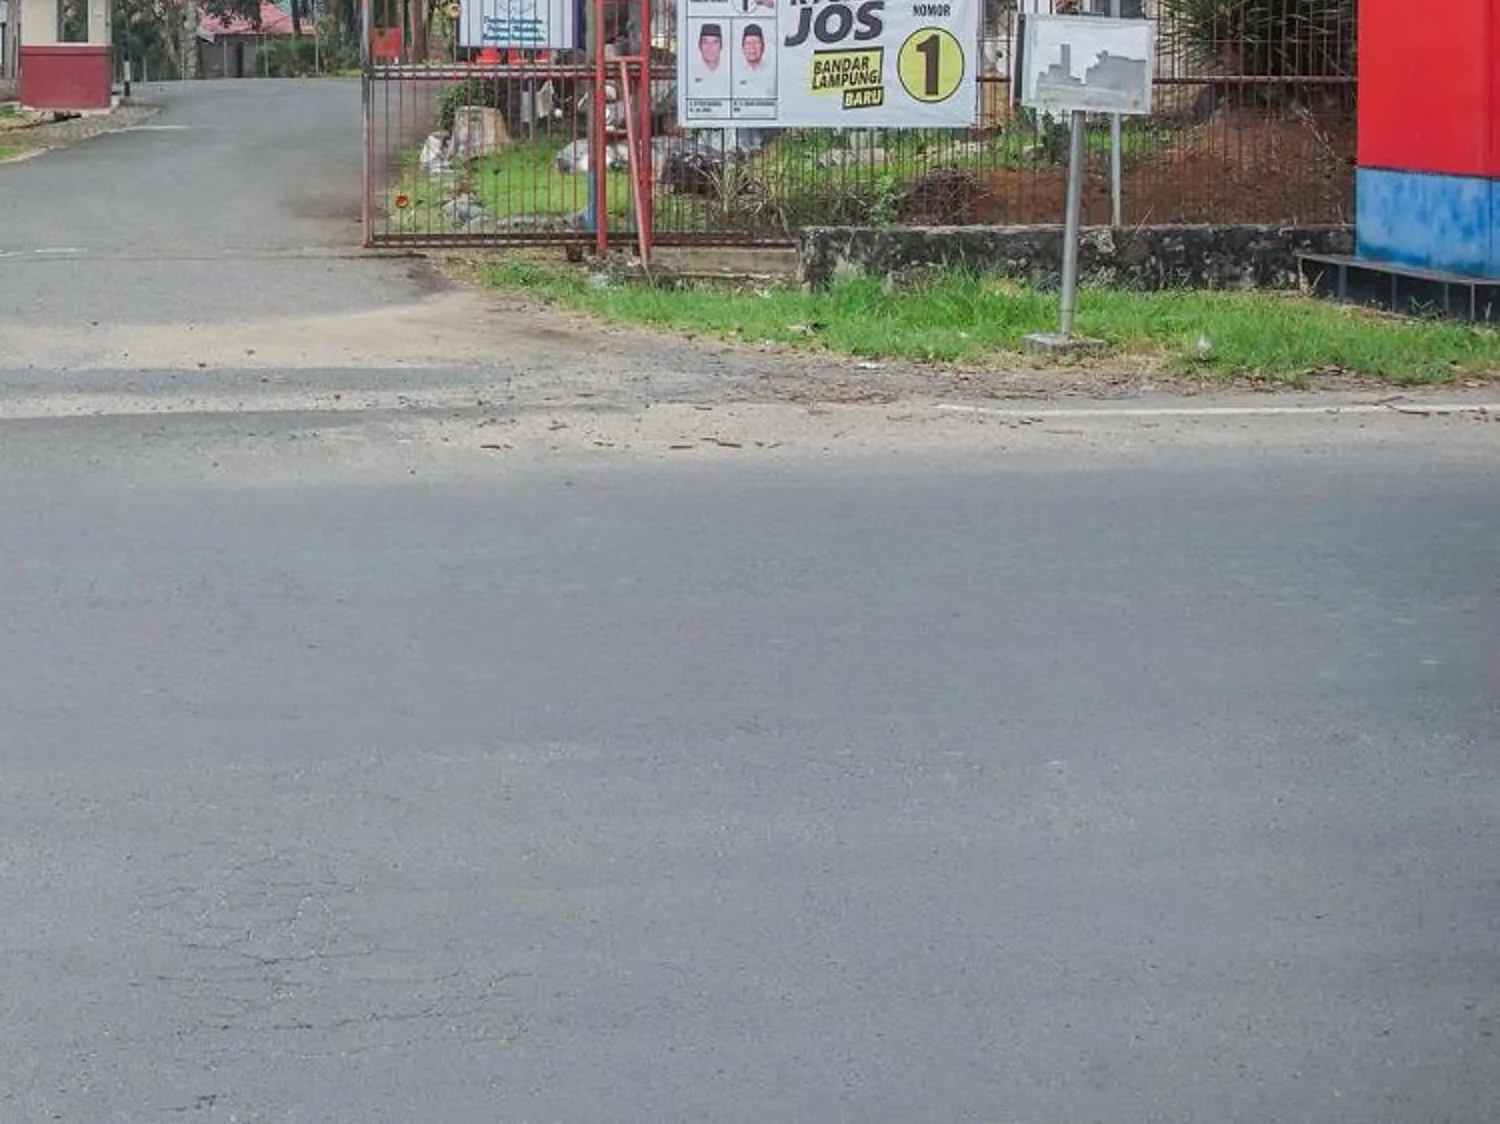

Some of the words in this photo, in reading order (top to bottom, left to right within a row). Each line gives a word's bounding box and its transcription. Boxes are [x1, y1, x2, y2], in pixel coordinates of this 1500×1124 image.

[913, 3, 951, 17] NOMOR
[783, 1, 885, 47] JOS
[814, 56, 871, 75] BANDAR
[916, 34, 940, 96] 1
[811, 69, 877, 90] LAMPUNG
[844, 88, 880, 107] BARU
